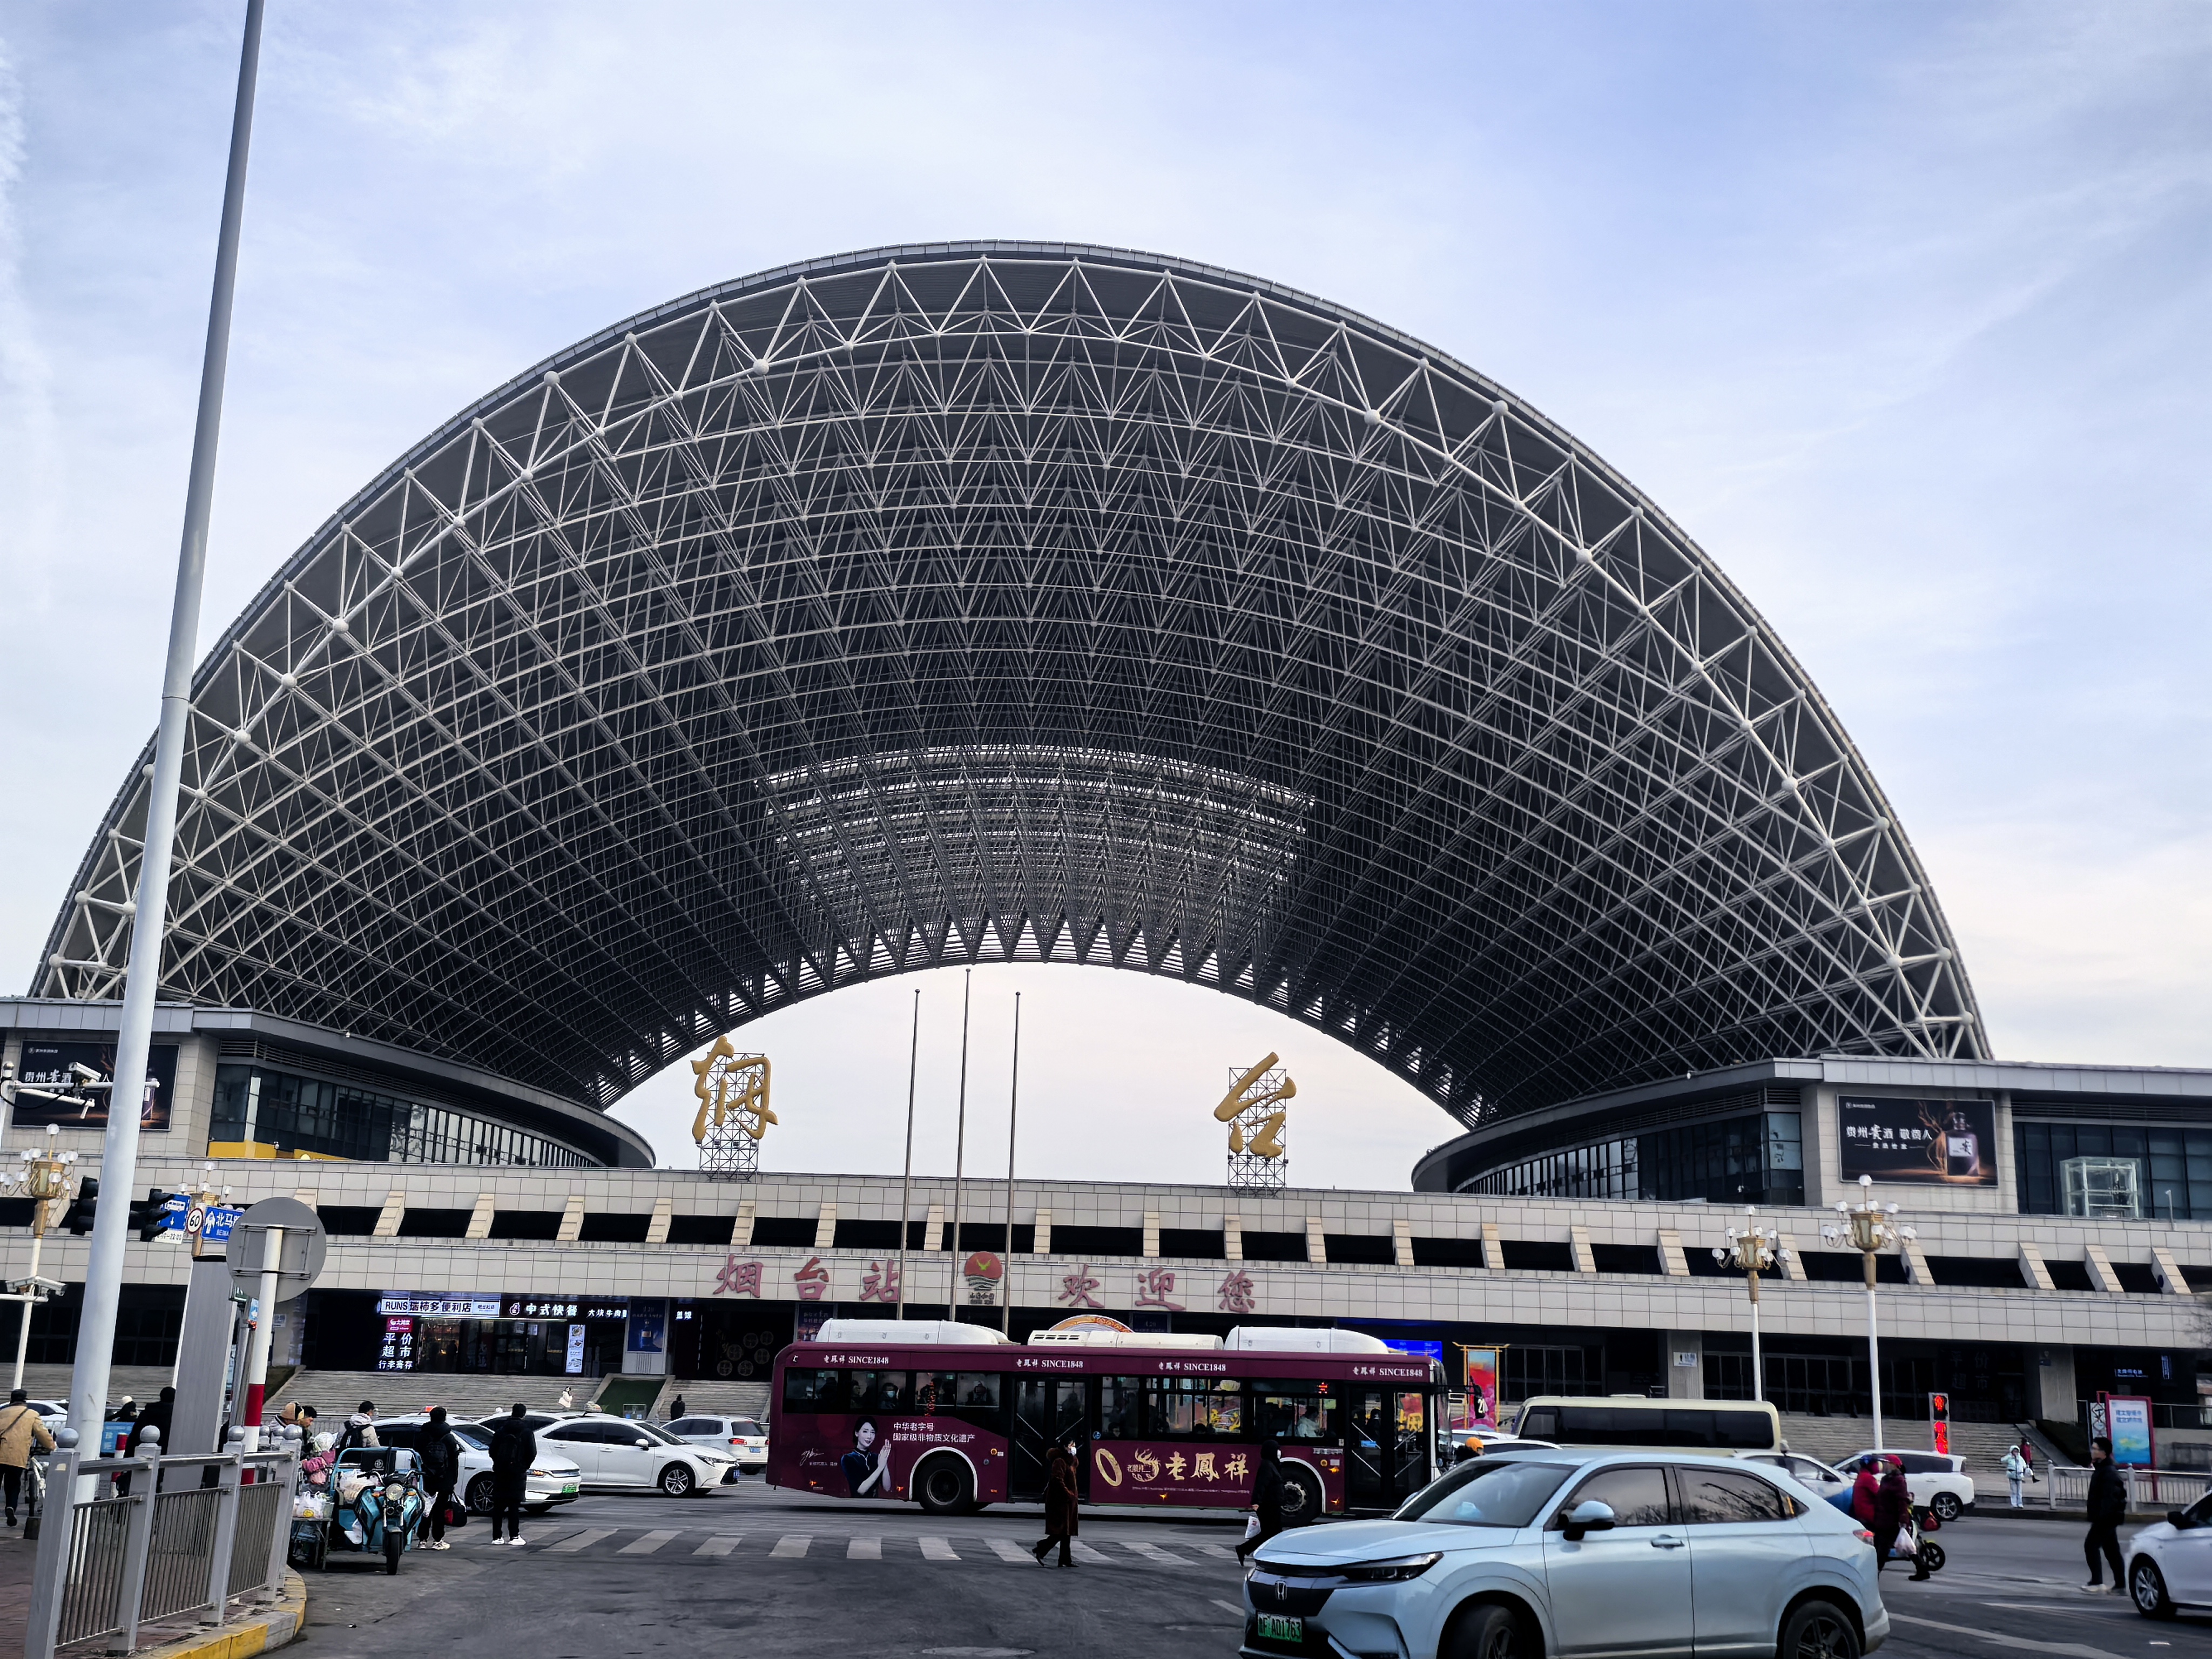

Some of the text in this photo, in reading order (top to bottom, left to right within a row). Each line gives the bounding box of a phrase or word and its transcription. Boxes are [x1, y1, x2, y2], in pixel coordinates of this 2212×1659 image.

[190, 1215, 200, 1227] 60
[713, 1255, 1256, 1313] 烟台站 欢迎您
[385, 1301, 408, 1311] RUNS
[525, 1303, 578, 1317] 中式快餐
[382, 1332, 413, 1345] 平价
[382, 1346, 412, 1358] 超市
[379, 1360, 413, 1370] 行李寄存
[848, 1355, 889, 1365] SINCE1848
[1041, 1359, 1084, 1368] SINCE1848
[1184, 1363, 1226, 1372] SINCE1848
[1379, 1367, 1423, 1377] SINCE1848
[893, 1422, 935, 1431] 中华老字号
[893, 1433, 975, 1442] 国家级非物质文化遗产
